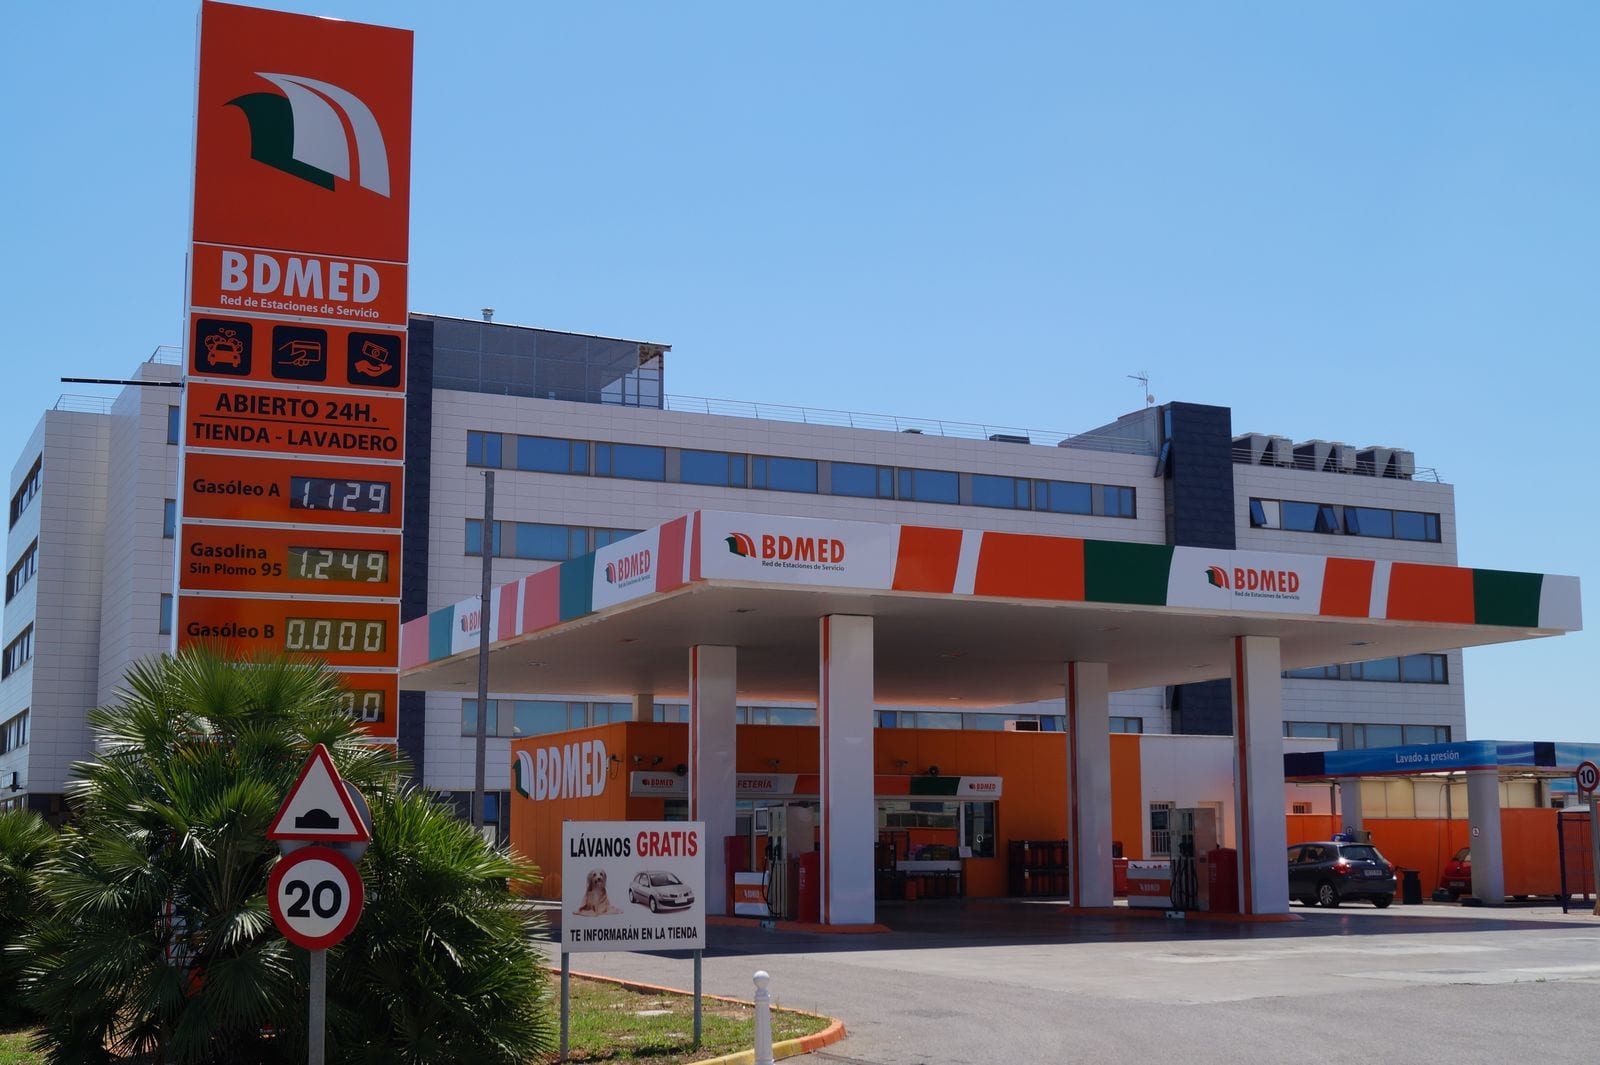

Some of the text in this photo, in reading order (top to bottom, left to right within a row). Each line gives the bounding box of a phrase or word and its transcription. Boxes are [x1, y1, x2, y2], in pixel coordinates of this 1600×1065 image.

[221, 250, 380, 303] BDMED
[220, 294, 380, 319] Red de Estaciones de Servicio
[216, 392, 378, 422] ABIERTO 24H.
[192, 422, 270, 443] TIENDA
[287, 429, 398, 452] LAVADERO
[192, 478, 386, 513] Gasóleo A 1.129
[190, 542, 267, 559] Gasolina
[762, 534, 845, 563] BDMED
[189, 550, 384, 582] Sin Plomo 95 1.249
[618, 549, 651, 582] BDMED
[762, 560, 773, 568] Red
[783, 562, 813, 570] Estaciones
[822, 564, 845, 572] Servicio
[1234, 568, 1299, 593] BDMED
[187, 620, 382, 652] Gasóleo B 0.000
[536, 739, 607, 801] BDMED
[1395, 752, 1422, 763] Lavado
[1431, 750, 1460, 764] presión
[1580, 769, 1595, 784] 10
[570, 831, 698, 857] LÁVANOS GRATIS
[285, 880, 342, 919] 20
[570, 924, 698, 942] TE INFORMARÁN EN LA TIENDA
